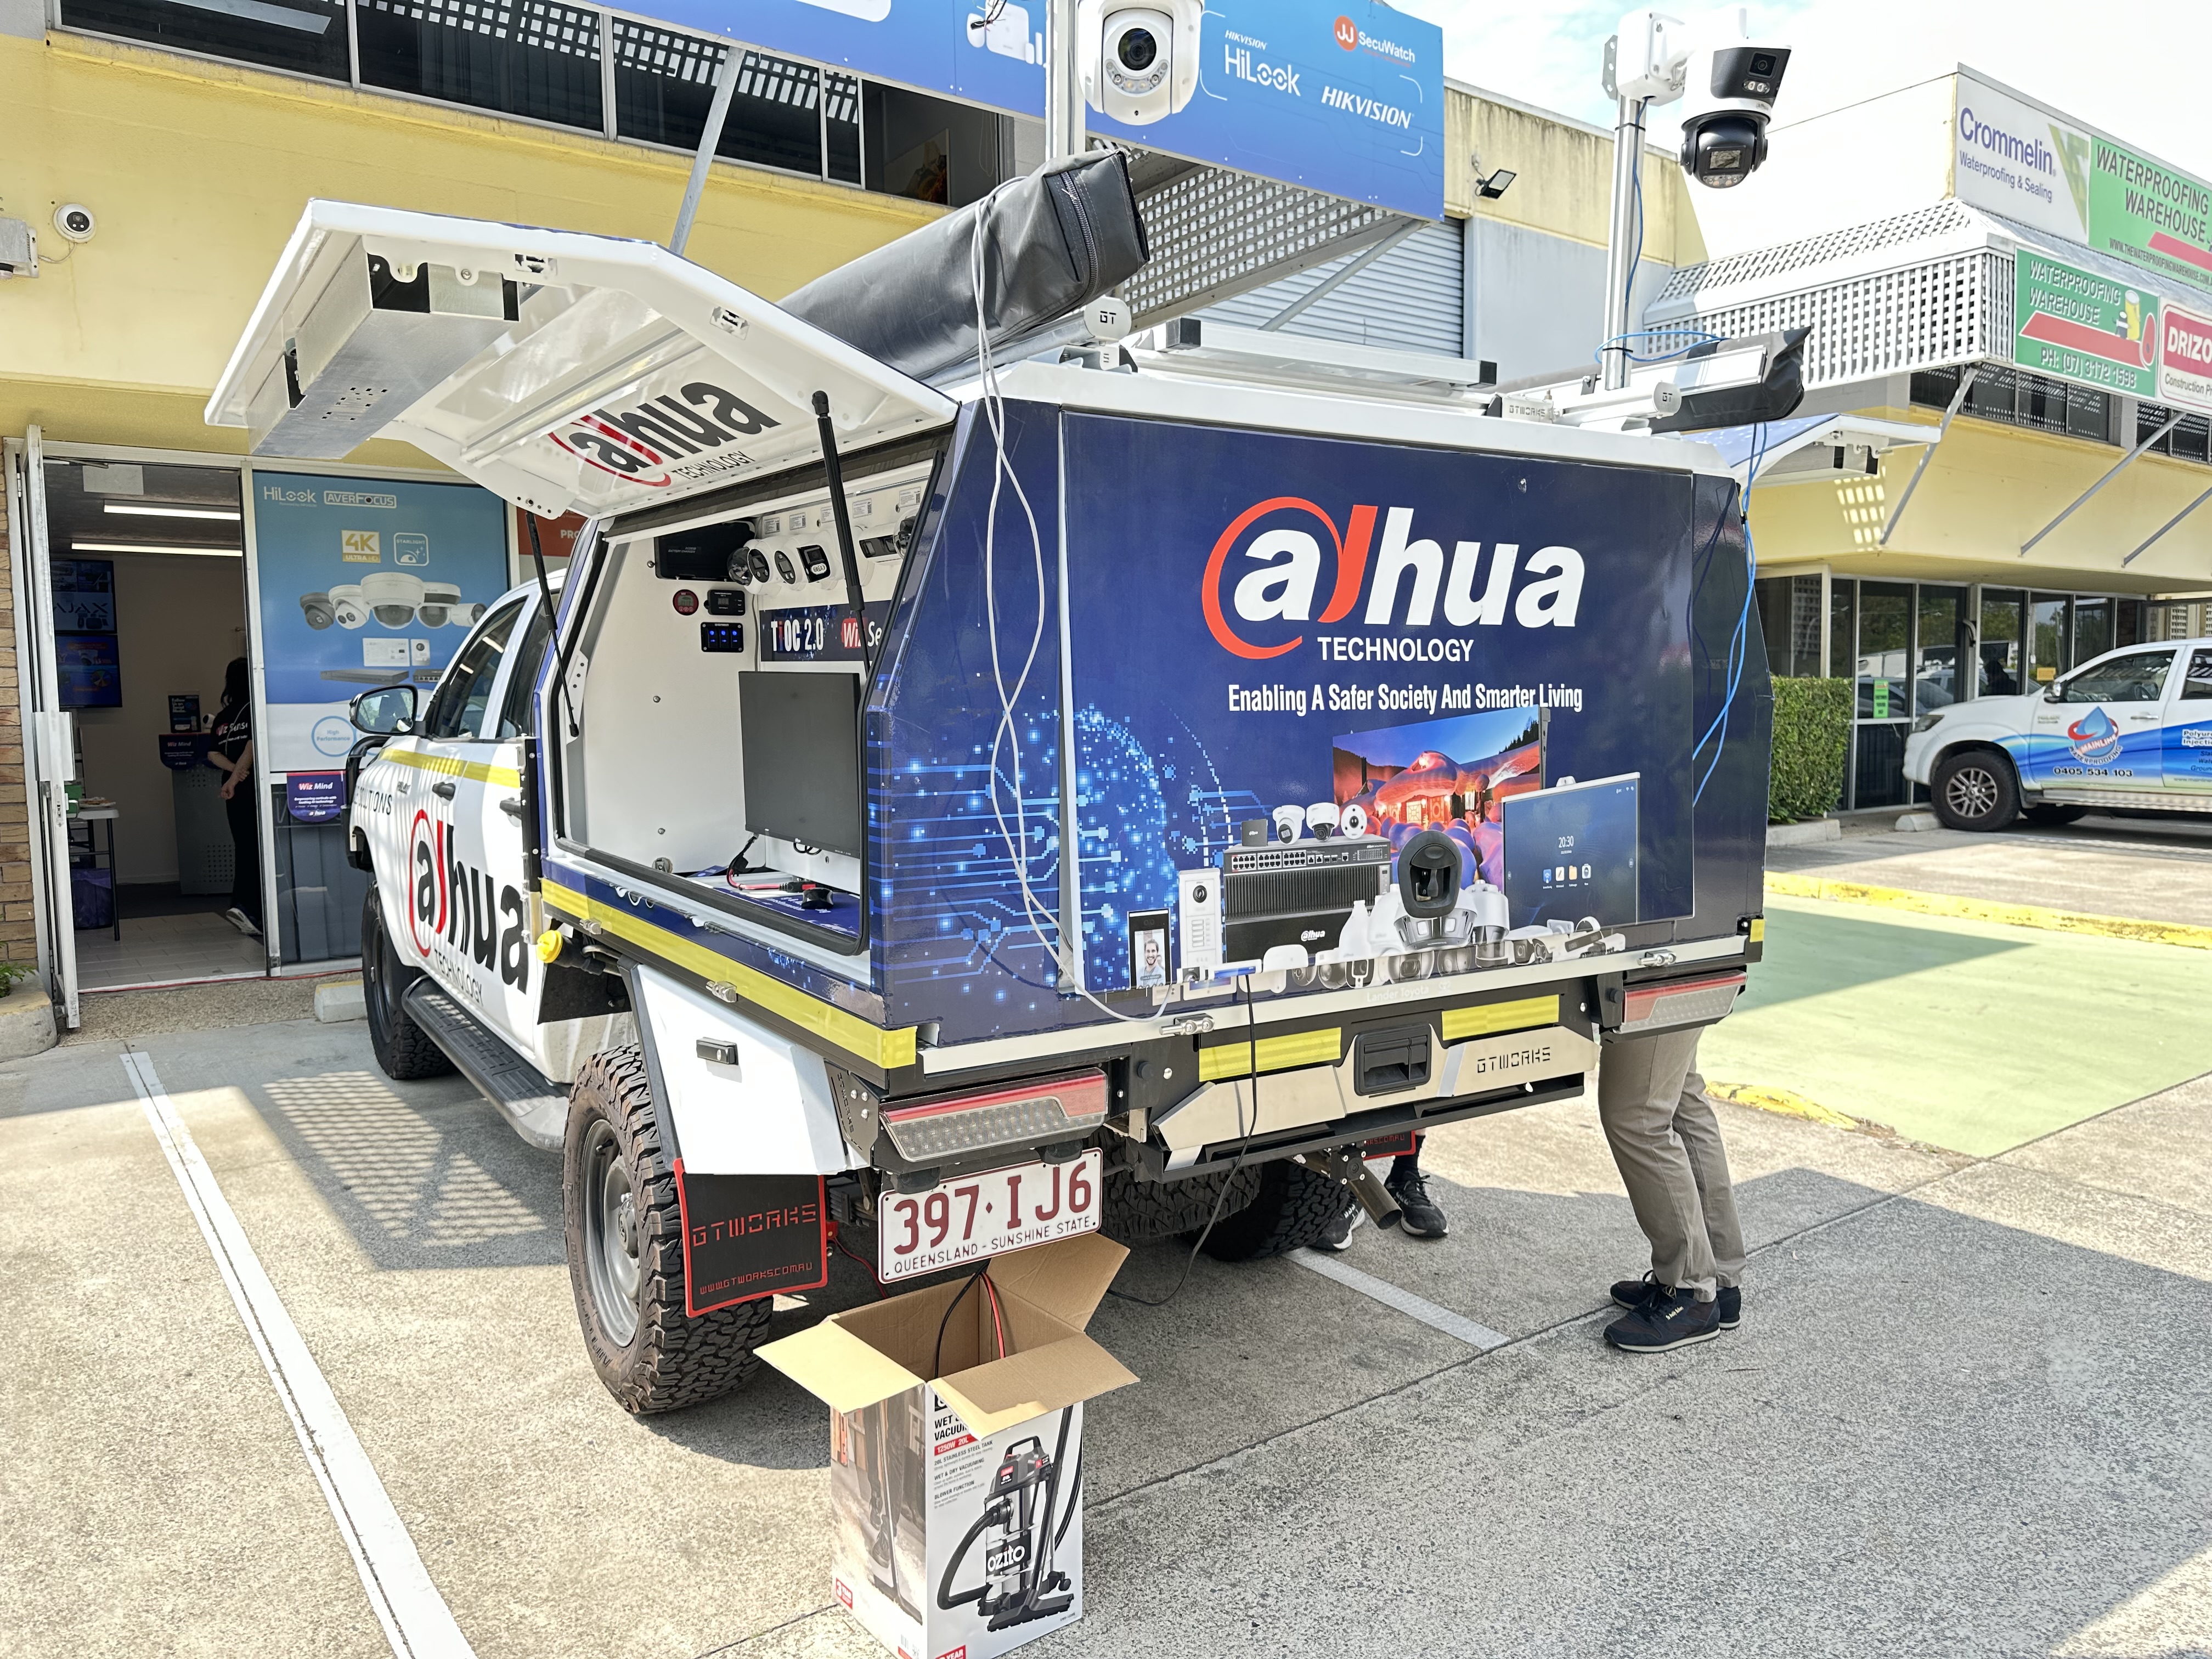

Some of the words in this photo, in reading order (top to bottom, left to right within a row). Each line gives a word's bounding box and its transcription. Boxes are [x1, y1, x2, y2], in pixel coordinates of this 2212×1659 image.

[1225, 30, 1267, 50] HIKVISION
[1337, 24, 1354, 43] JJ
[1358, 31, 1415, 63] SecuWatch
[1225, 44, 1301, 97] HiLook
[1321, 86, 1412, 129] HIKVISION
[1960, 108, 2053, 176] Crommelin
[1960, 150, 2015, 189] Waterproofing
[2017, 176, 2023, 189] &
[2025, 178, 2052, 203] Sealing
[2097, 144, 2209, 215] WATERPROOFING
[2125, 188, 2206, 242] WAREHOUSE
[2030, 259, 2121, 306] WATERPROOFING
[2030, 286, 2101, 325] WAREHOUSE
[2062, 351, 2083, 377] (07)
[2165, 373, 2204, 394] Construction
[671, 450, 756, 481] TECHNOLOGY
[264, 486, 317, 503] HiLook
[327, 492, 394, 506] AVERFOCUS
[345, 533, 376, 552] 4K
[804, 618, 823, 650] 2.0
[1318, 636, 1474, 662] TECHNOLOGY
[1228, 684, 1307, 717] Enabling
[1311, 685, 1324, 711] A
[1328, 682, 1374, 711] Safer
[1378, 684, 1436, 715] Society
[1441, 682, 1471, 709] And
[1475, 684, 1536, 709] Smarter
[1538, 683, 1582, 713] Living
[2054, 767, 2083, 776] 0405
[1558, 836, 1574, 848] 20:30
[435, 949, 483, 1006] TECHNOLOGY
[1367, 990, 1398, 1002] Lander
[1400, 986, 1429, 1000] Toyota
[1477, 1047, 1550, 1073] GTWORKS
[692, 1203, 816, 1246] GTWORKS
[894, 1244, 978, 1273] QUEENSLAND
[991, 1226, 1050, 1250] SUNSHINE
[1057, 1216, 1090, 1234] STATE
[934, 1415, 953, 1429] WET
[937, 1440, 956, 1453] 1250W
[958, 1436, 969, 1446] 20L
[944, 1449, 966, 1462] STAINLESS
[968, 1445, 980, 1453] STEEL
[959, 1458, 985, 1471] VACUUMING
[934, 1489, 952, 1500] BLOWER
[953, 1480, 974, 1492] FUNCTION
[988, 1543, 1025, 1573] ozito
